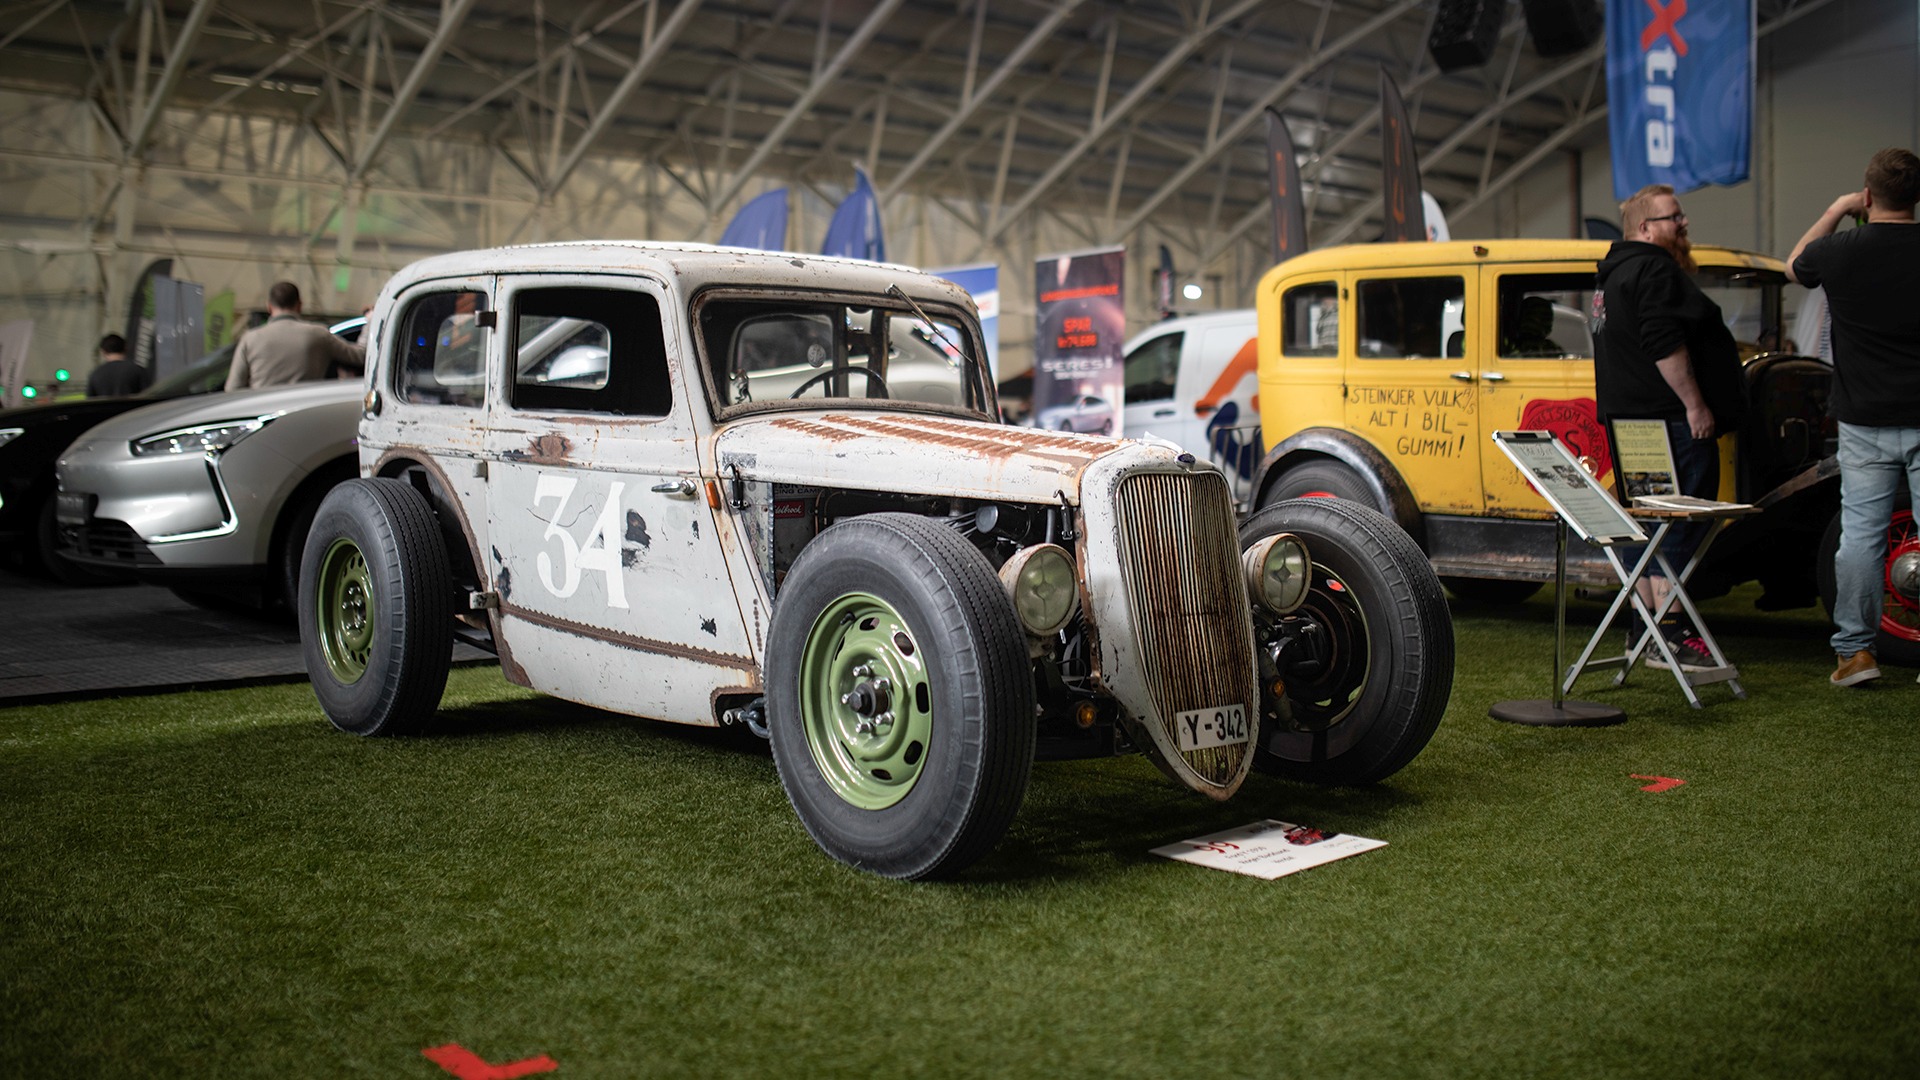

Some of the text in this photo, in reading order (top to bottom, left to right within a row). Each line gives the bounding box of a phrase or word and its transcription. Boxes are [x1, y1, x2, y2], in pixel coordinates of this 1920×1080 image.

[1042, 359, 1104, 373] SERES
[1350, 388, 1416, 406] STEINKJER
[1368, 410, 1398, 427] ALT
[1565, 430, 1582, 458] S
[775, 504, 802, 515] delbrock
[533, 474, 630, 609] 34
[1184, 708, 1245, 746] Y-342
[1193, 840, 1240, 854] 99
